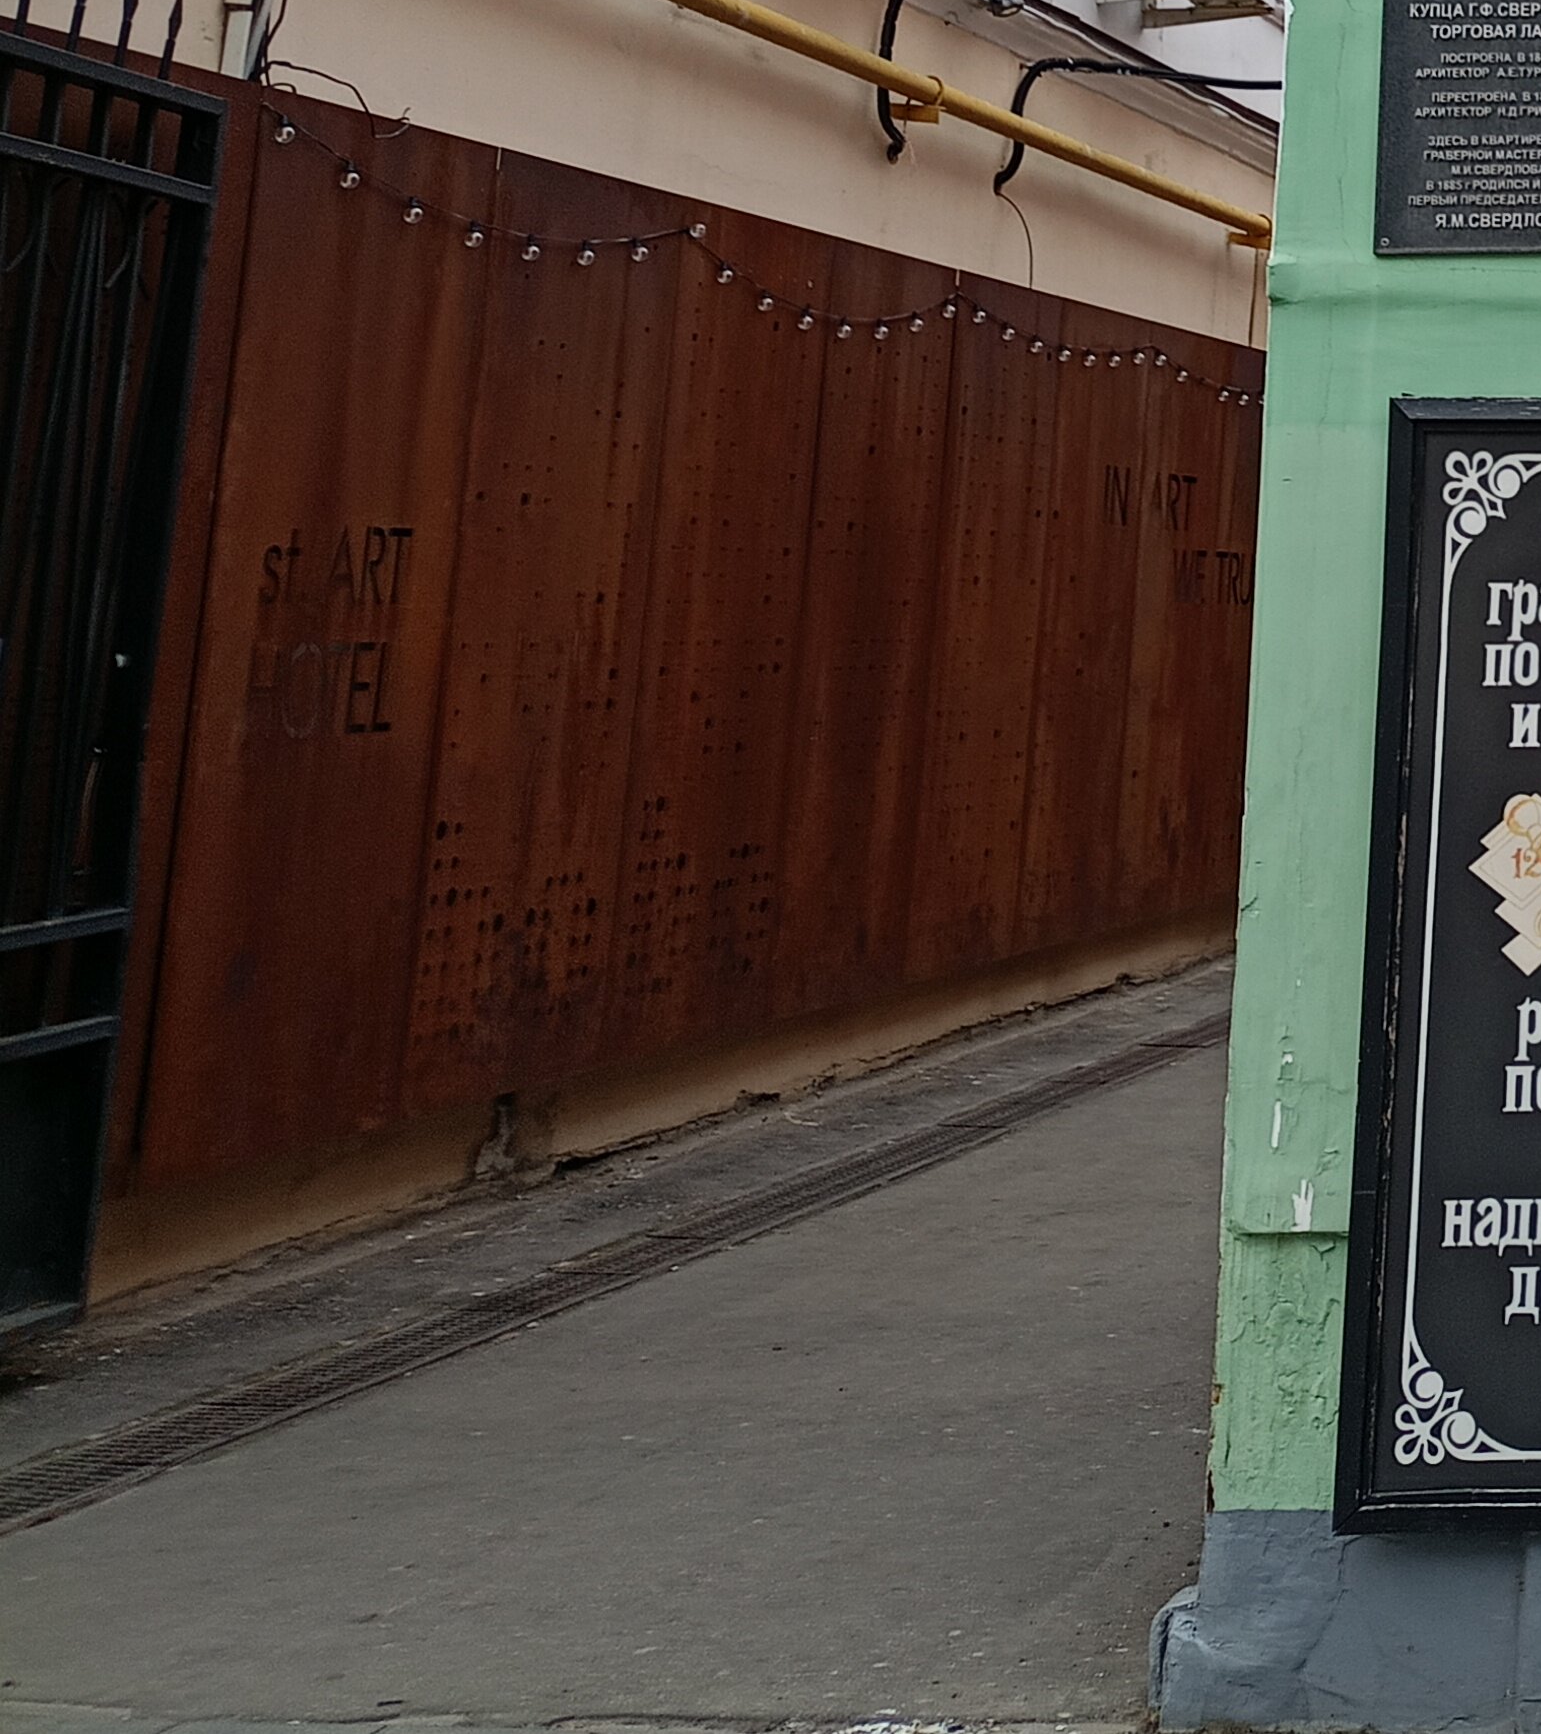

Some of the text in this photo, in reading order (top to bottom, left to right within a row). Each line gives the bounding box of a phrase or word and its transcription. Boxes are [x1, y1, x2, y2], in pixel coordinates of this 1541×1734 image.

[1409, 3, 1464, 19] КУПЦА
[1430, 24, 1516, 39] ТОРГОВАЯ
[1441, 52, 1512, 63] ПОСТРОЕНА
[1517, 52, 1526, 63] В
[1415, 68, 1490, 78] АРХИТЕКТОР
[1431, 92, 1517, 103] ПЕРЕСТРОЕНА
[1522, 92, 1531, 102] В
[1415, 107, 1492, 117] АРХИТЕКТОР
[1427, 135, 1468, 146] ЗДЕСЬ
[1470, 135, 1479, 146] В
[1426, 180, 1435, 190] В
[1472, 179, 1530, 191] РОДИЛСЯ
[1532, 179, 1541, 189] И
[1408, 193, 1457, 206] ПЕРВЫЙ
[1481, 639, 1541, 689] по
[1509, 702, 1541, 750] и
[1511, 848, 1541, 879] 12
